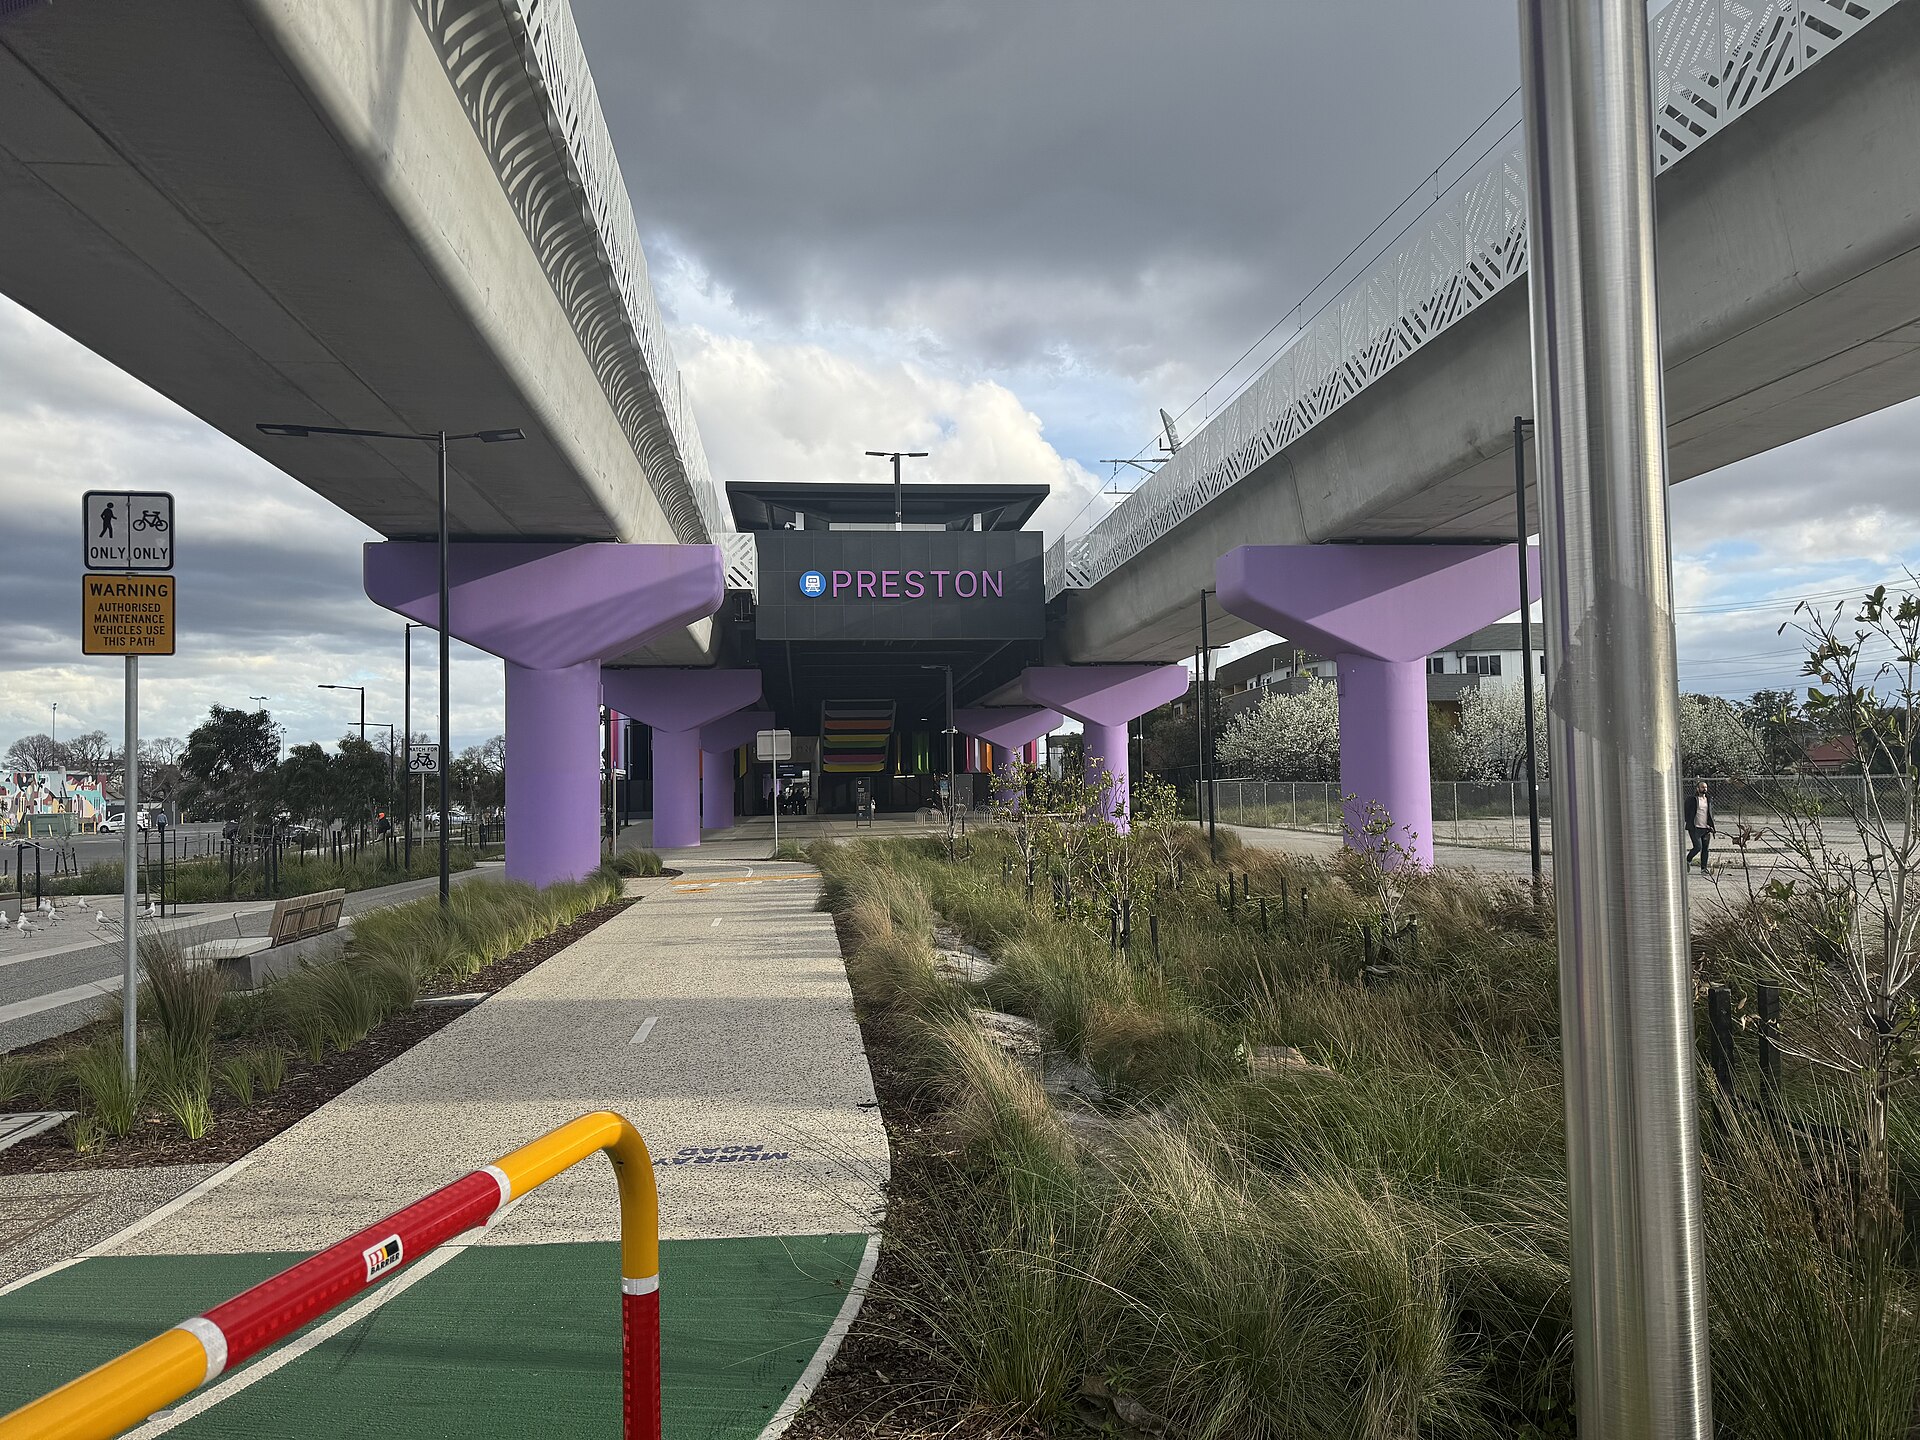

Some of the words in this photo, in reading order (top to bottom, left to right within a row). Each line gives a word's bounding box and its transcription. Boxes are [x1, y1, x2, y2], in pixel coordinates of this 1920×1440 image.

[90, 546, 126, 559] ONLY
[133, 547, 168, 560] ONLY
[90, 583, 168, 597] WARNING
[832, 570, 1003, 598] PRESTON
[98, 603, 161, 613] AUTHORISED
[94, 614, 165, 624] MAINTENANCE
[93, 625, 142, 635] VEHICLES
[146, 625, 166, 635] USE
[103, 636, 126, 646] THIS
[129, 636, 156, 647] PATH
[678, 1144, 764, 1156] ROAD
[652, 1152, 788, 1166] MURRAY
[370, 1252, 400, 1275] BARRIER
